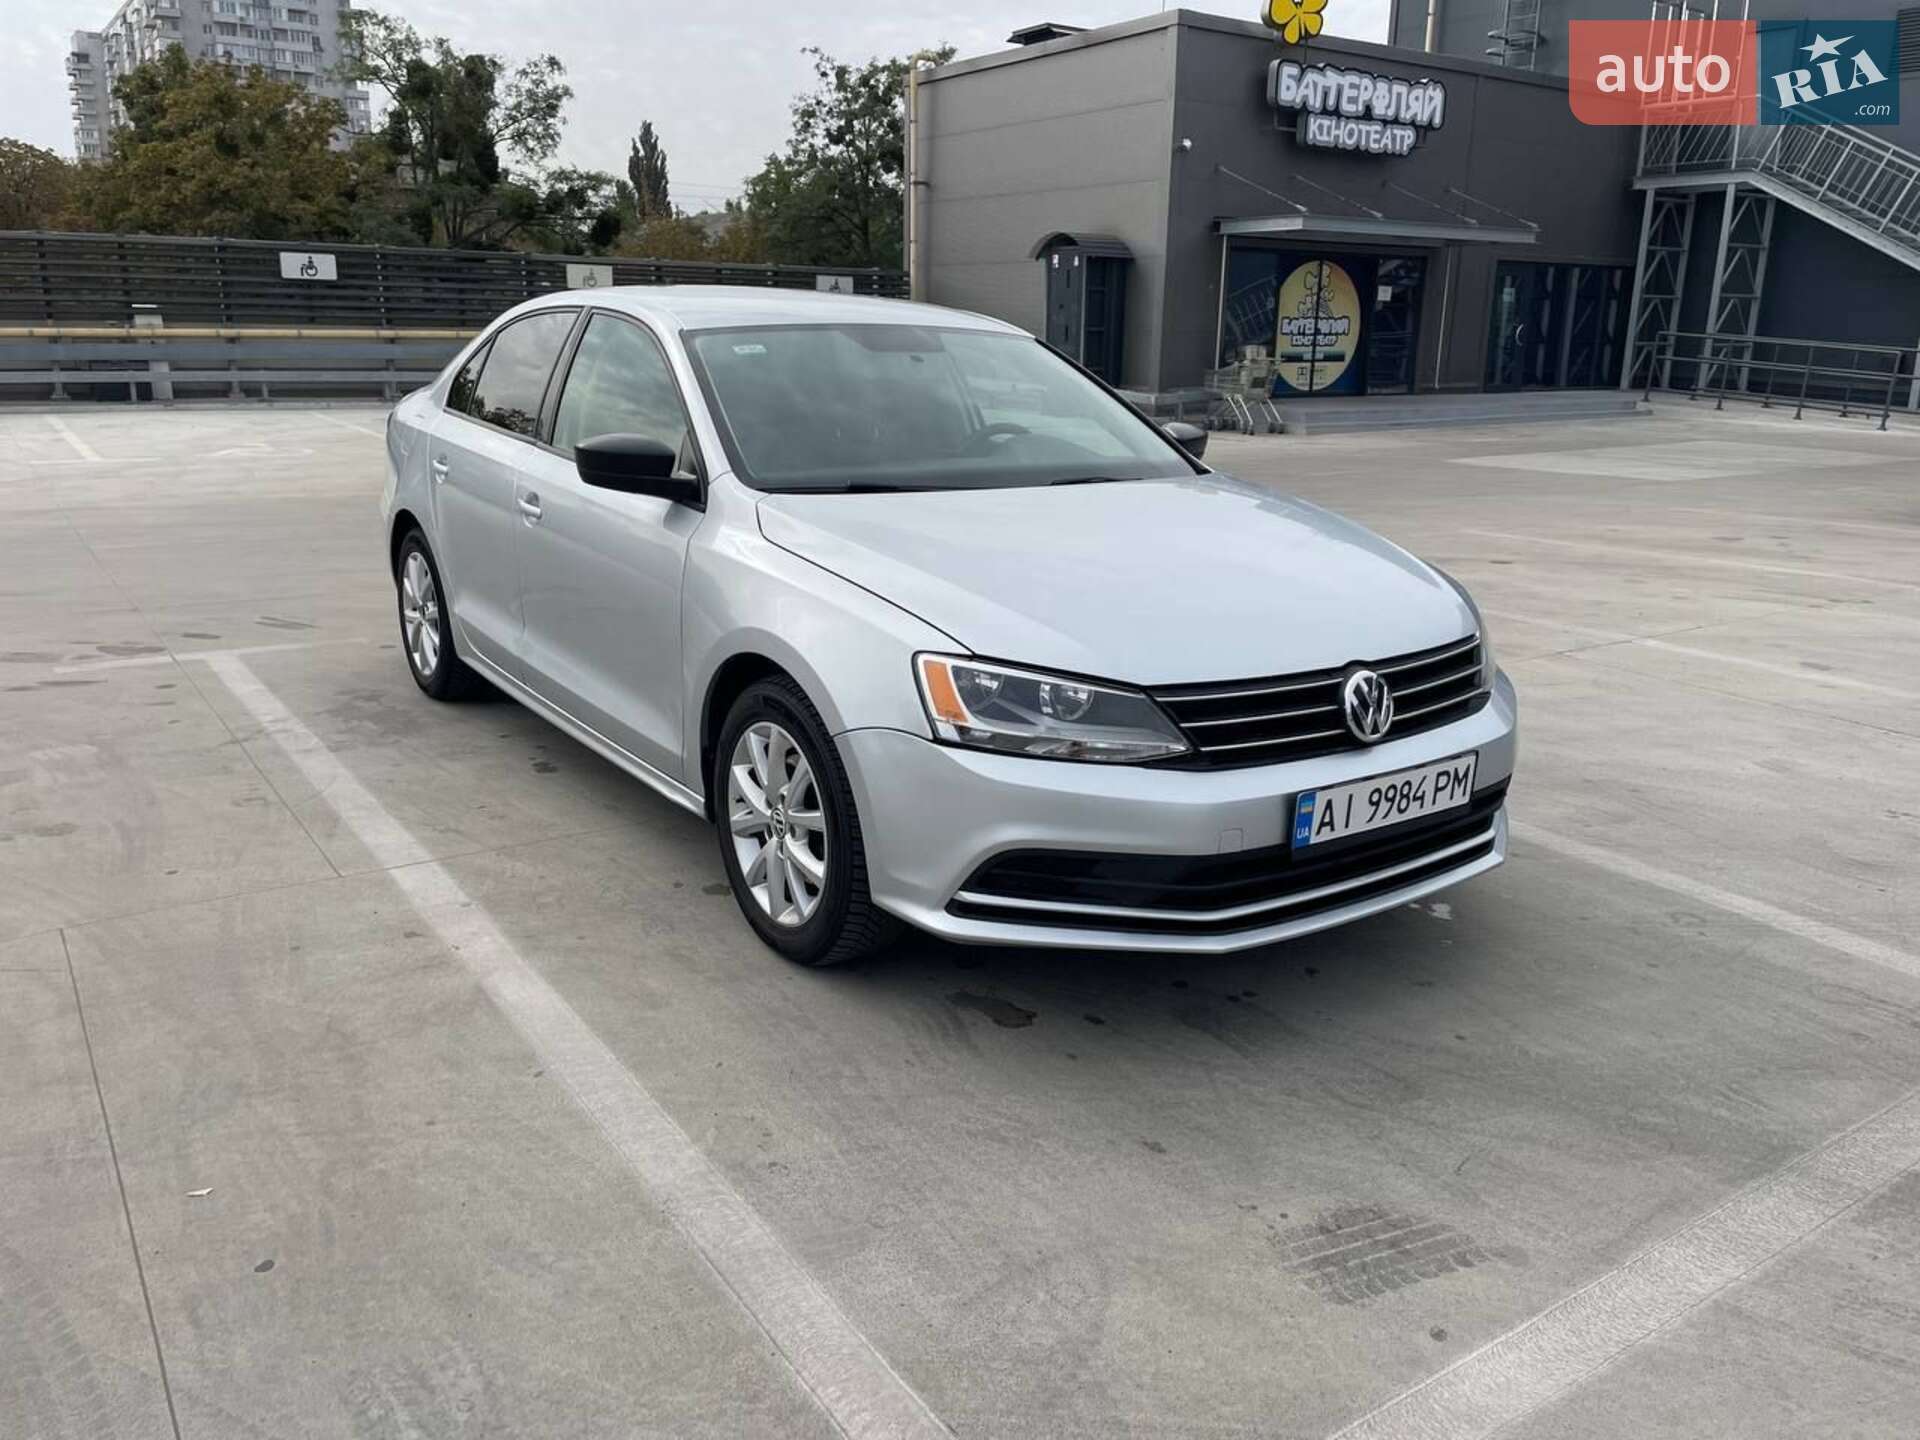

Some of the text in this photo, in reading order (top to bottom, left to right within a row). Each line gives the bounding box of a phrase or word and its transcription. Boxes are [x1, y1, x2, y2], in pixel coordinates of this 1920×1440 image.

[1308, 117, 1415, 151] КІНОТЕАТР
[1315, 763, 1471, 836] AI 9984 PM
